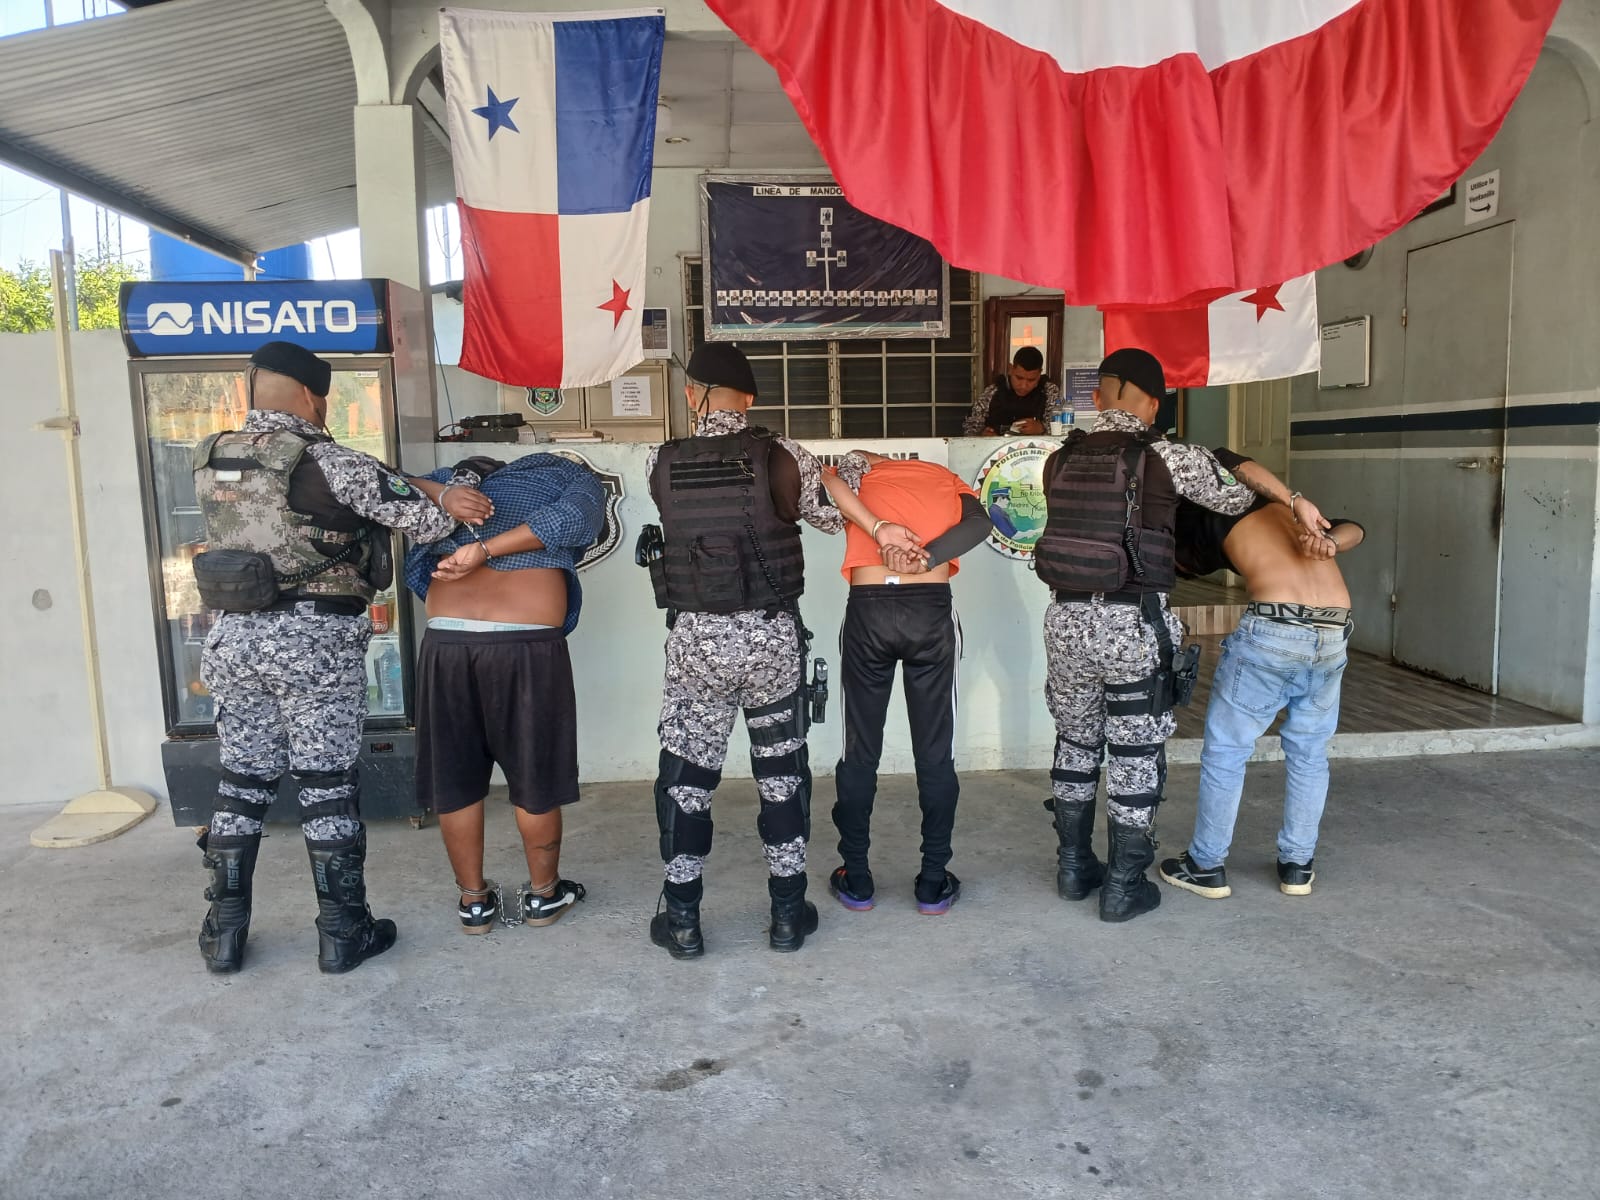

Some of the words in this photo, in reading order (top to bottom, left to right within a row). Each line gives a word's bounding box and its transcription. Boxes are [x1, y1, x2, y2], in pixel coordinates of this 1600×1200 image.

[756, 187, 782, 195] LINEA
[789, 187, 801, 195] DE
[810, 187, 842, 195] MANDO
[1470, 180, 1488, 191] Utilice
[1469, 190, 1495, 203] Ventanilla
[203, 300, 357, 334] NISATO
[996, 451, 1028, 468] POLICIA
[227, 858, 240, 890] MSR
[315, 861, 330, 893] MSR
